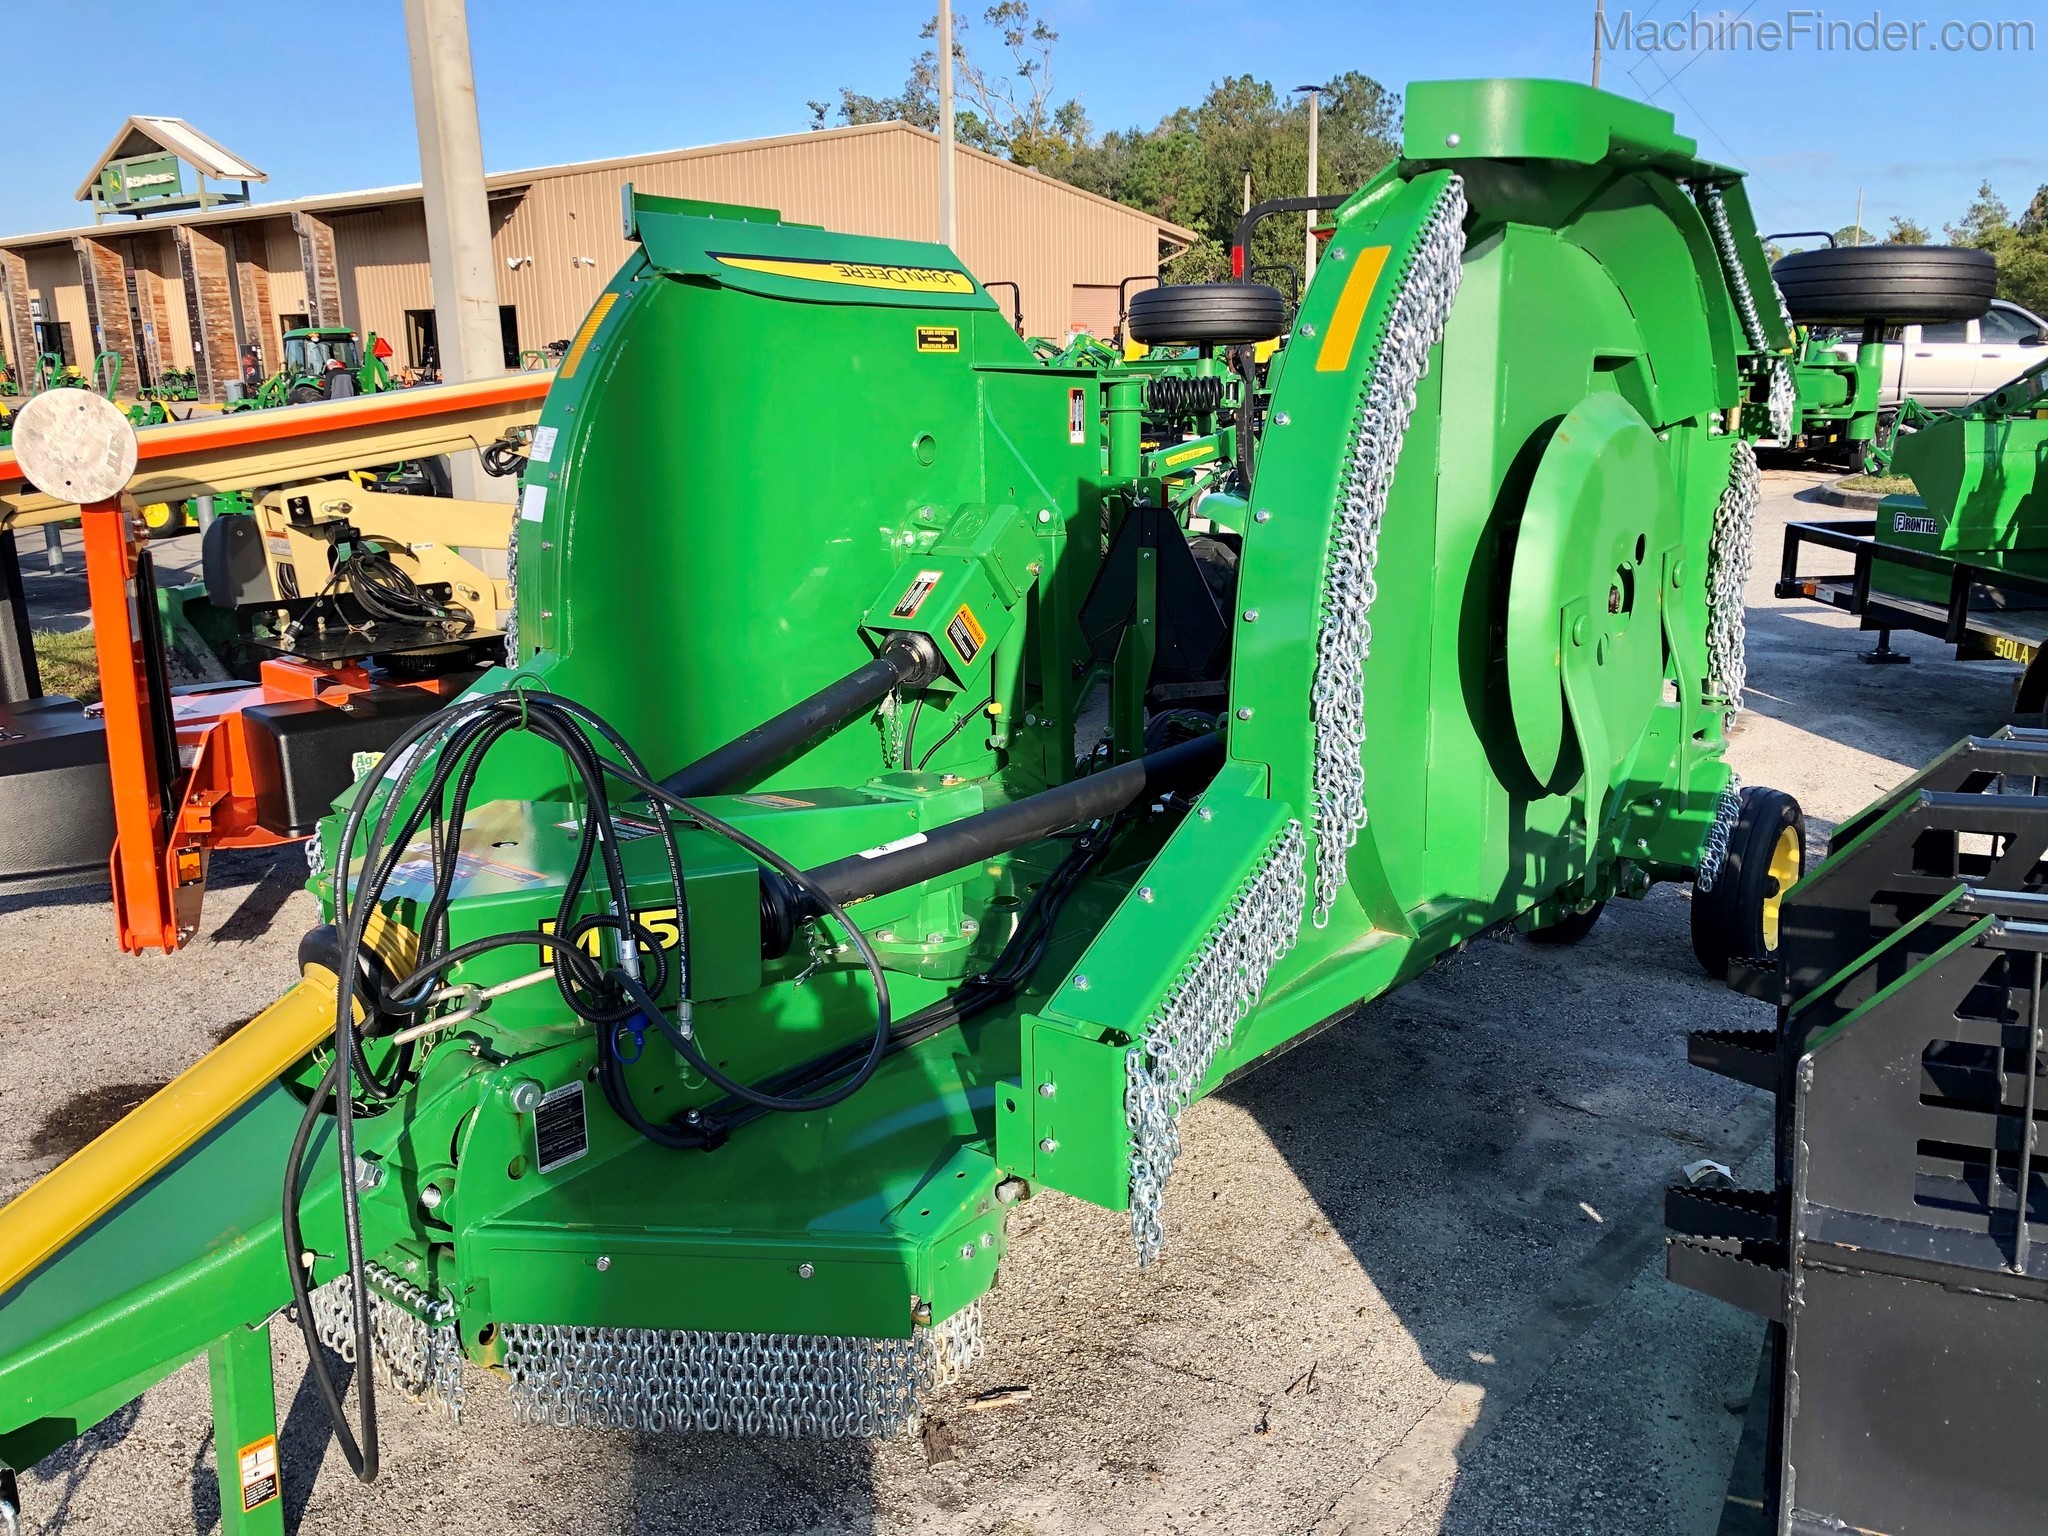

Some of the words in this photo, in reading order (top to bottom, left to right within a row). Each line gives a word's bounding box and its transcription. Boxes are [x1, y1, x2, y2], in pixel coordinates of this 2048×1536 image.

[839, 264, 906, 284] DEERE
[909, 269, 957, 287] JOHN
[965, 616, 985, 644] WARNING
[248, 1438, 273, 1453] WARNING
